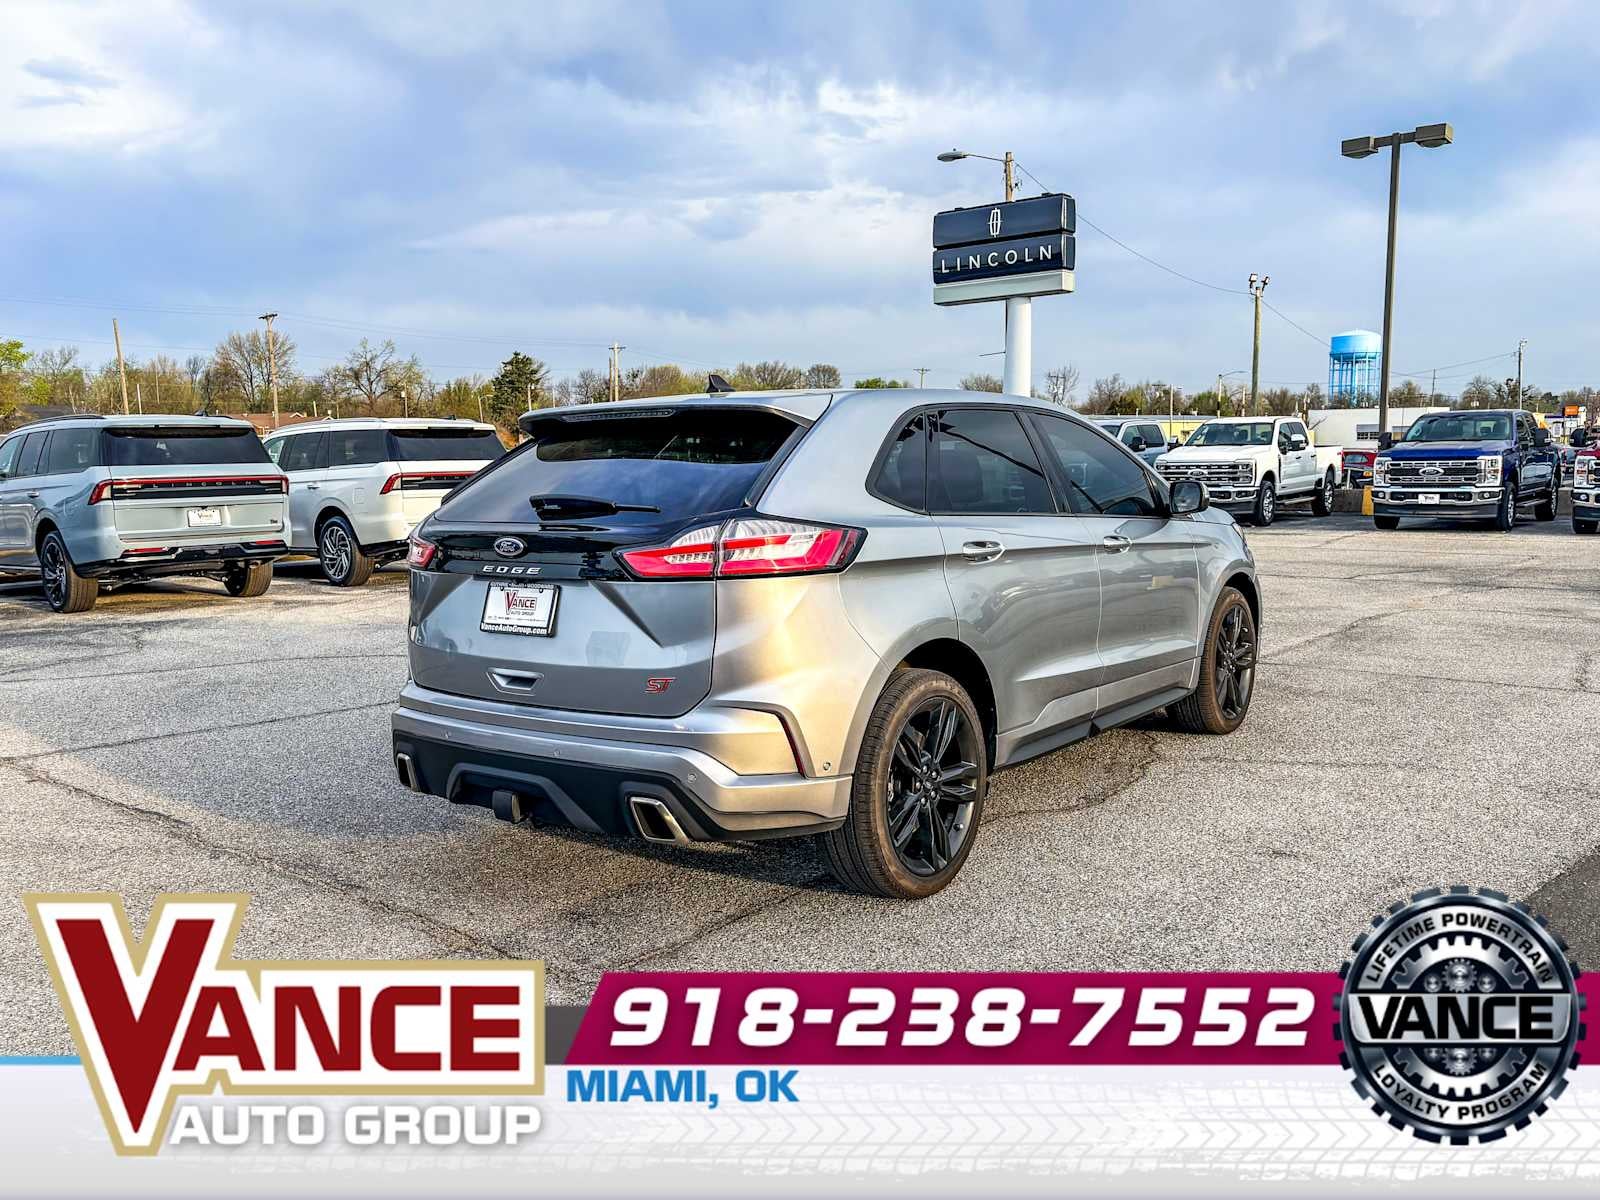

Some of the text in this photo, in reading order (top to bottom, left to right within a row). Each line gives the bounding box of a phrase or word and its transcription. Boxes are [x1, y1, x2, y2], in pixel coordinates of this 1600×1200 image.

[941, 245, 1052, 273] LINCOLN
[482, 565, 541, 575] EDGE
[505, 590, 536, 611] VANCE
[481, 622, 547, 635] VanceAutoGroup.com
[645, 677, 676, 693] ST
